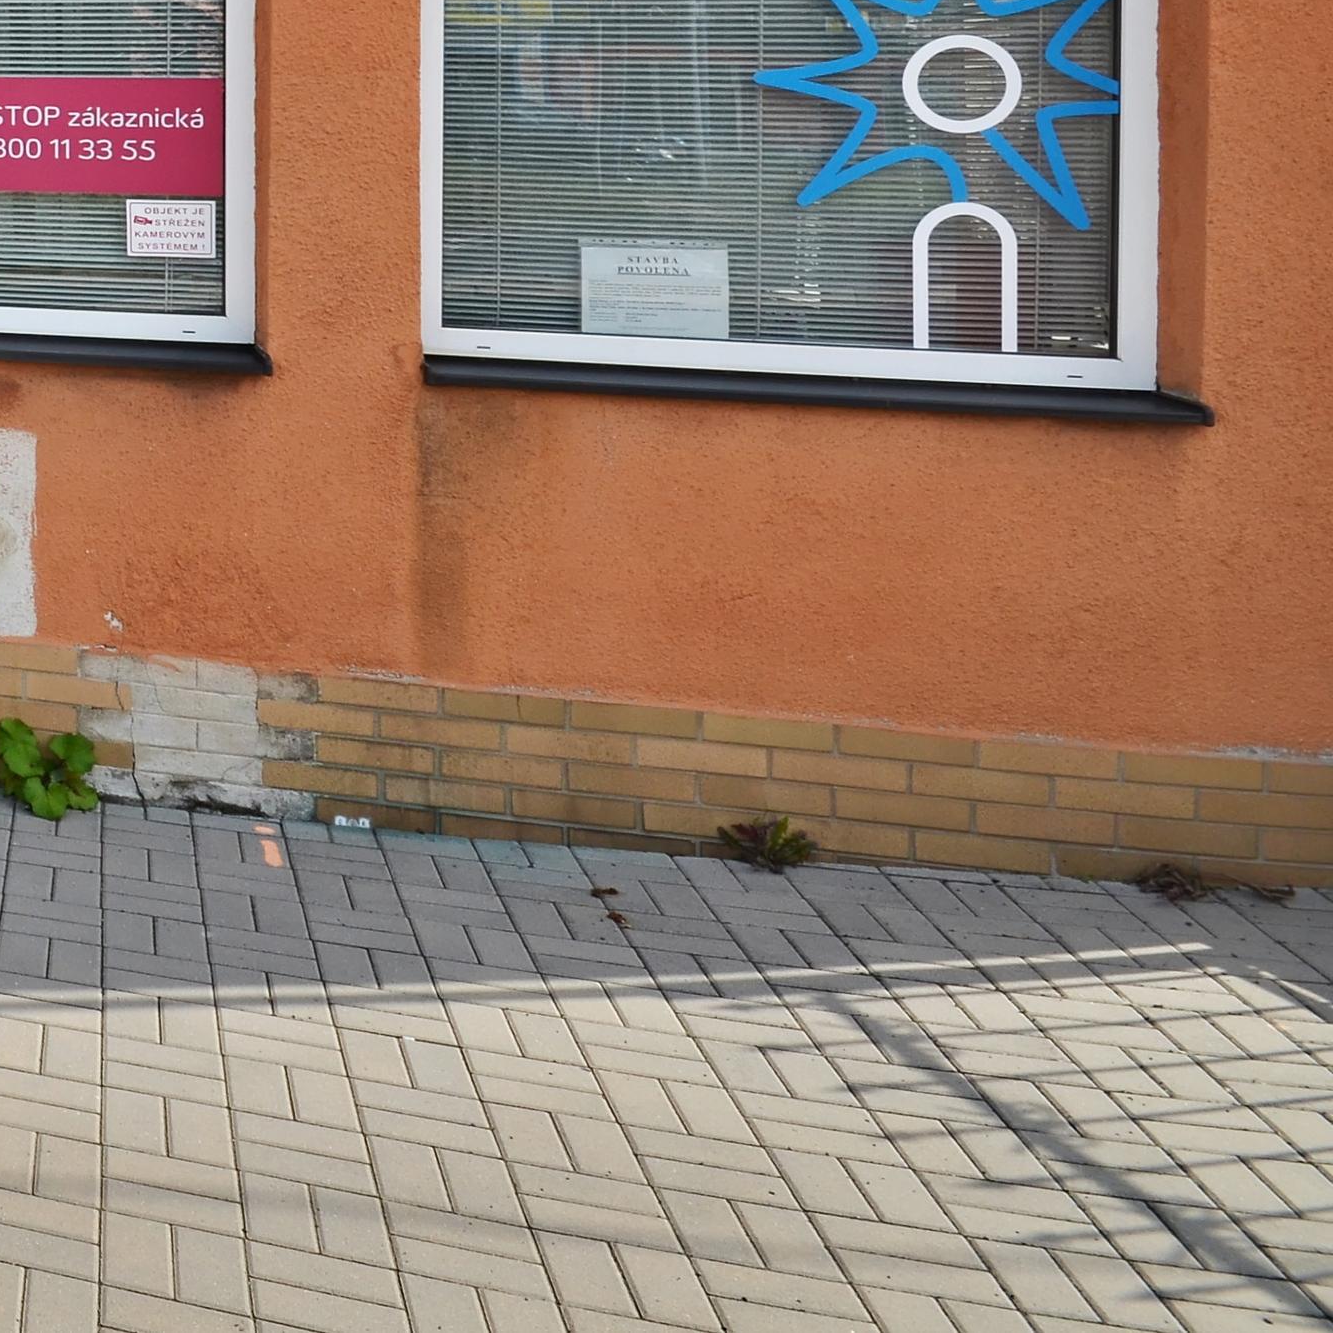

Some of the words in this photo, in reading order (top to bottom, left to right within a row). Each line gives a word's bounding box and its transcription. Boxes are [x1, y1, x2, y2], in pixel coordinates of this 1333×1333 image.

[67, 106, 204, 129] zákaznická
[49, 138, 71, 160] 11
[78, 138, 113, 161] 33
[120, 139, 156, 161] 55
[144, 207, 189, 215] OBJEKT
[192, 207, 206, 216] JE
[154, 218, 206, 227] STŘEŽEN
[627, 256, 679, 265] STAVBA
[616, 266, 690, 276] POVOLENA
